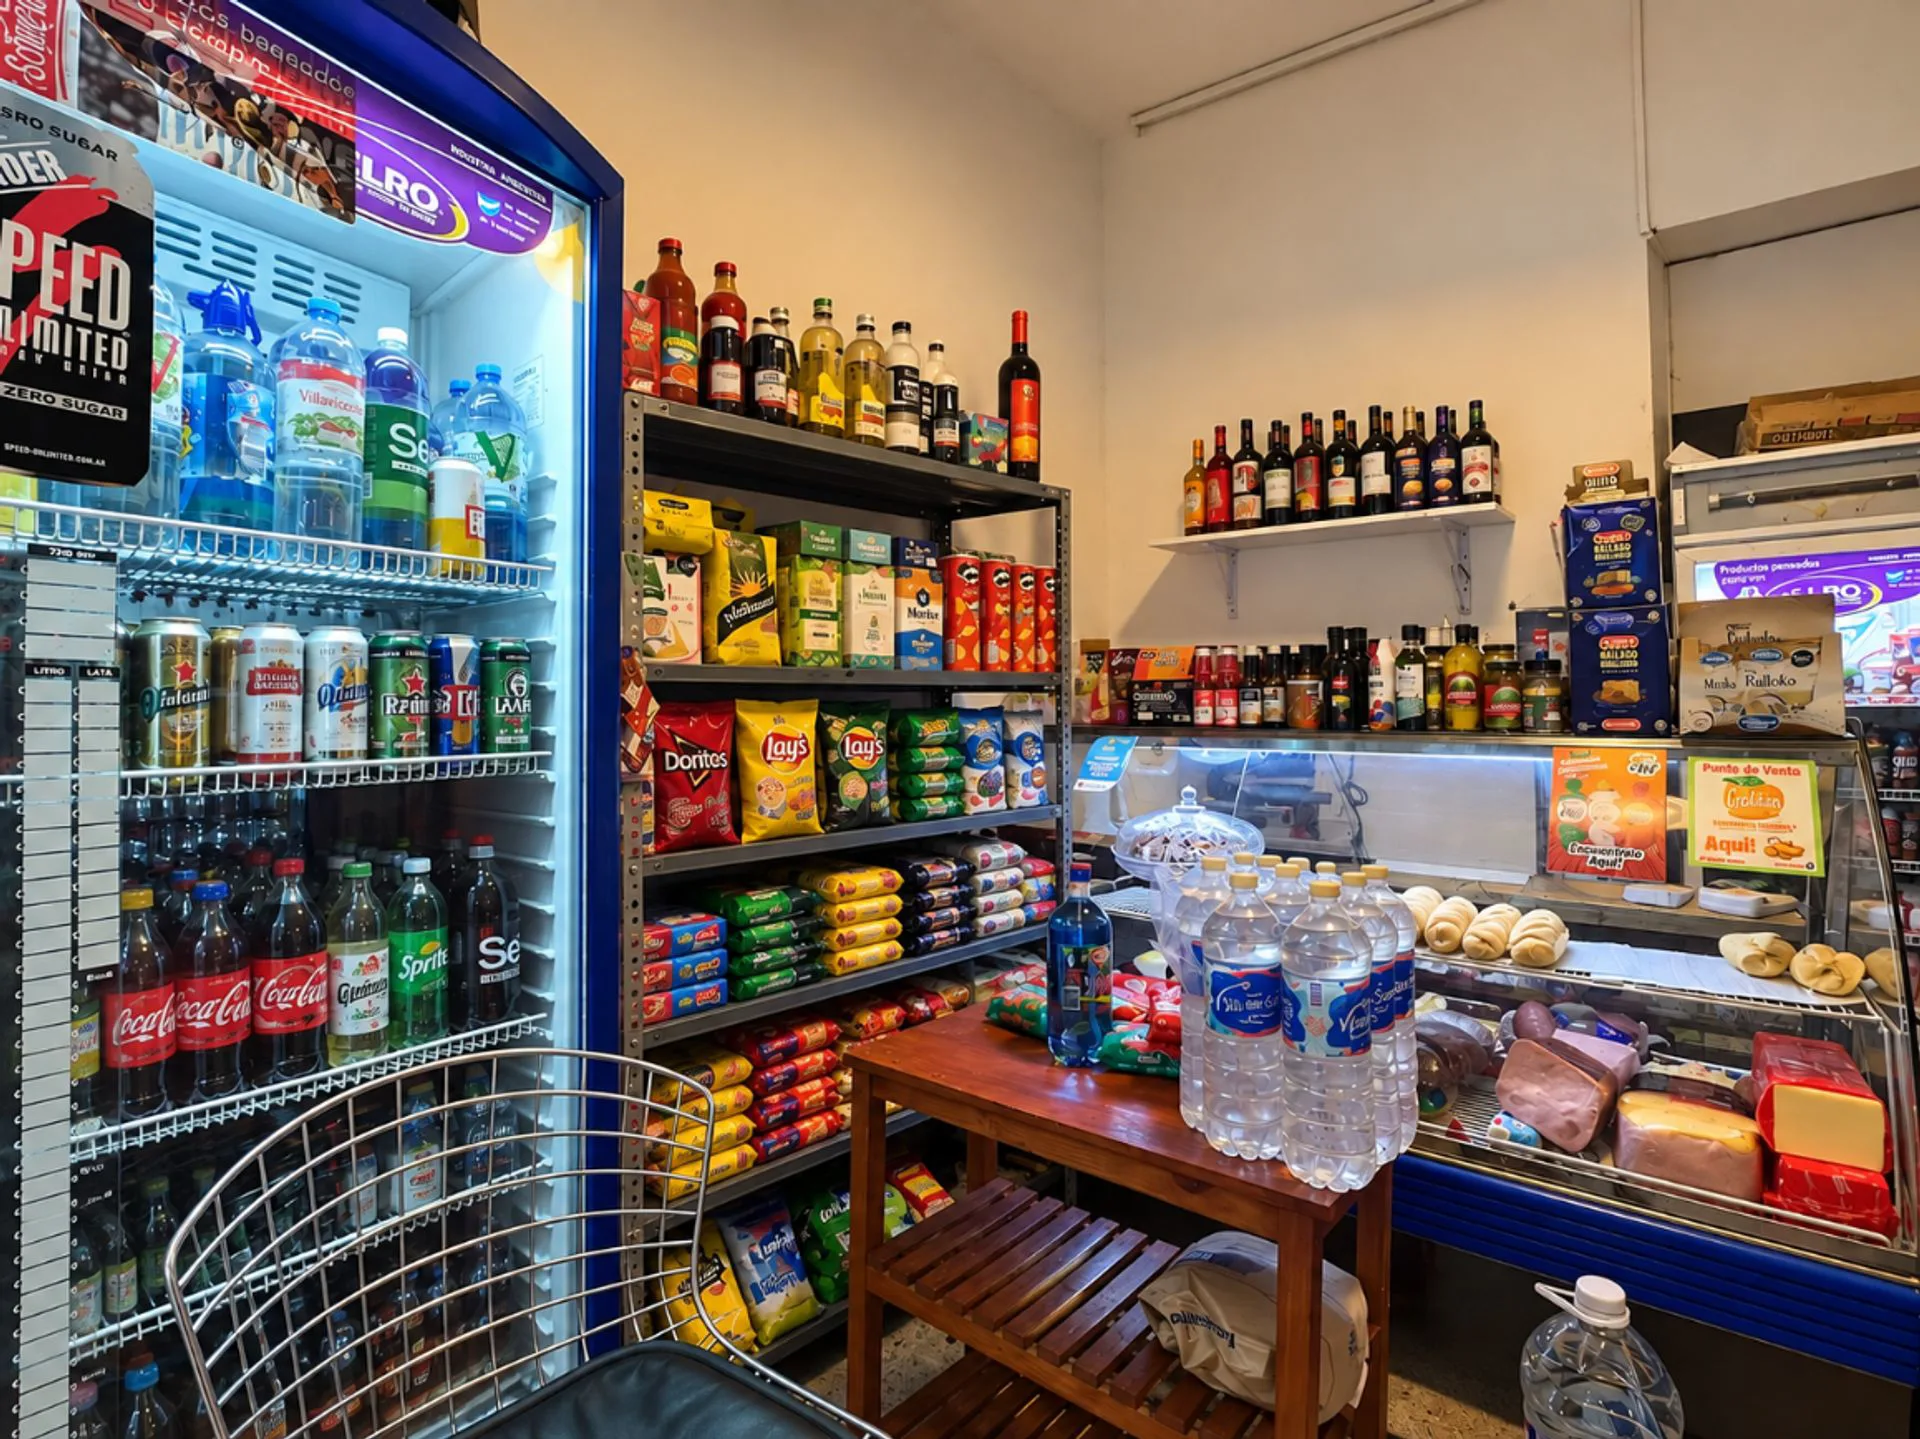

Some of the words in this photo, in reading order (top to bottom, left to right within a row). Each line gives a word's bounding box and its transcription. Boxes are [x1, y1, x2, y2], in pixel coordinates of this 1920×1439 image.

[3, 384, 57, 405] ZERO
[61, 396, 125, 420] SUGAR
[766, 733, 808, 762] Lay's
[844, 735, 884, 761] Lay's
[1702, 762, 1740, 775] Punto
[1762, 765, 1802, 777] Venta
[398, 948, 449, 982] Sprite
